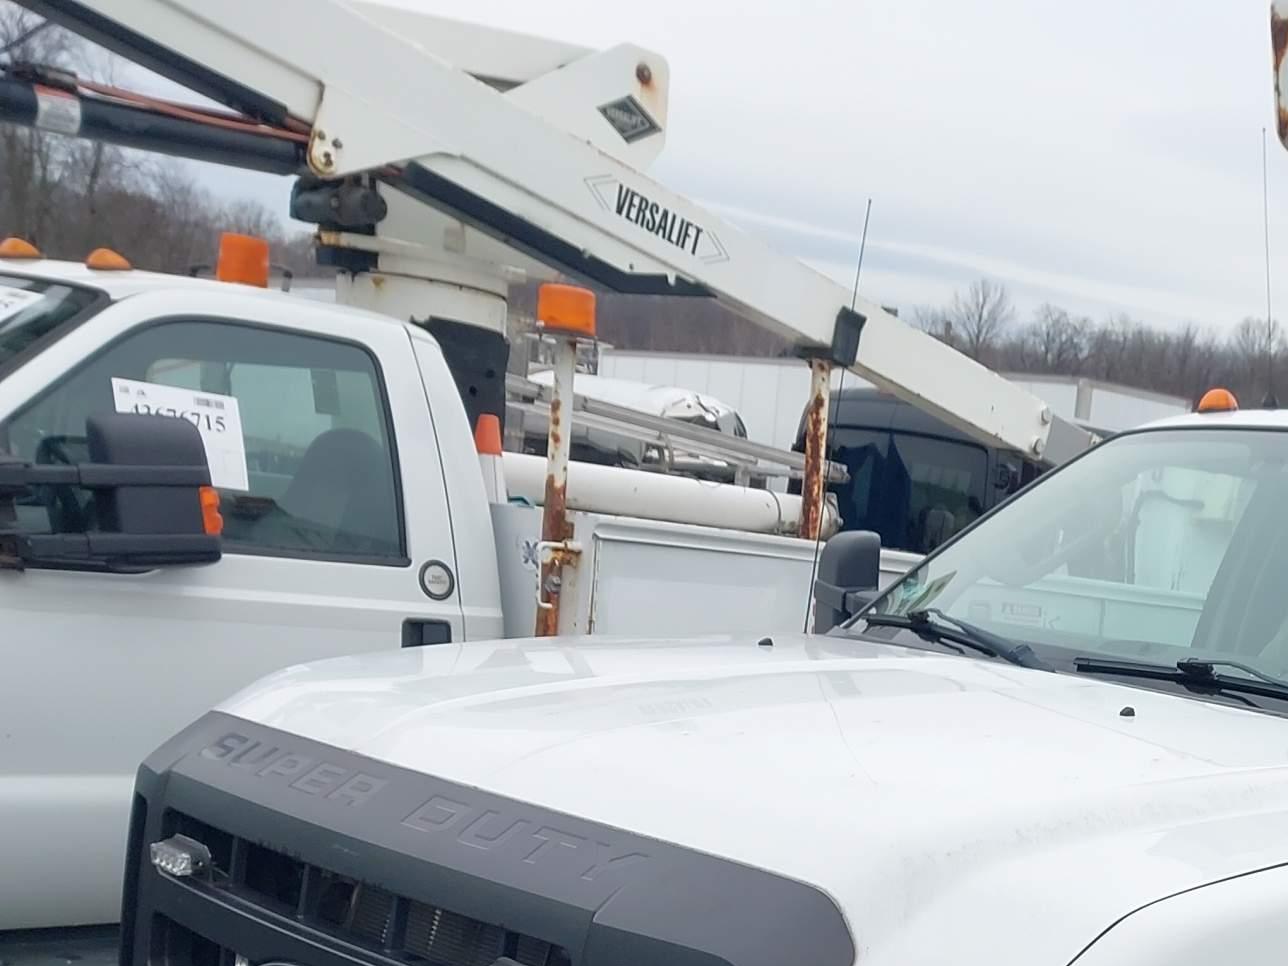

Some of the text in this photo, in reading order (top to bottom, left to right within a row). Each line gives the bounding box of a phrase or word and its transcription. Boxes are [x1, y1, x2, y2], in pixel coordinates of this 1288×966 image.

[615, 183, 703, 256] VERSALIFT
[199, 731, 650, 881] SUPER DUTY
